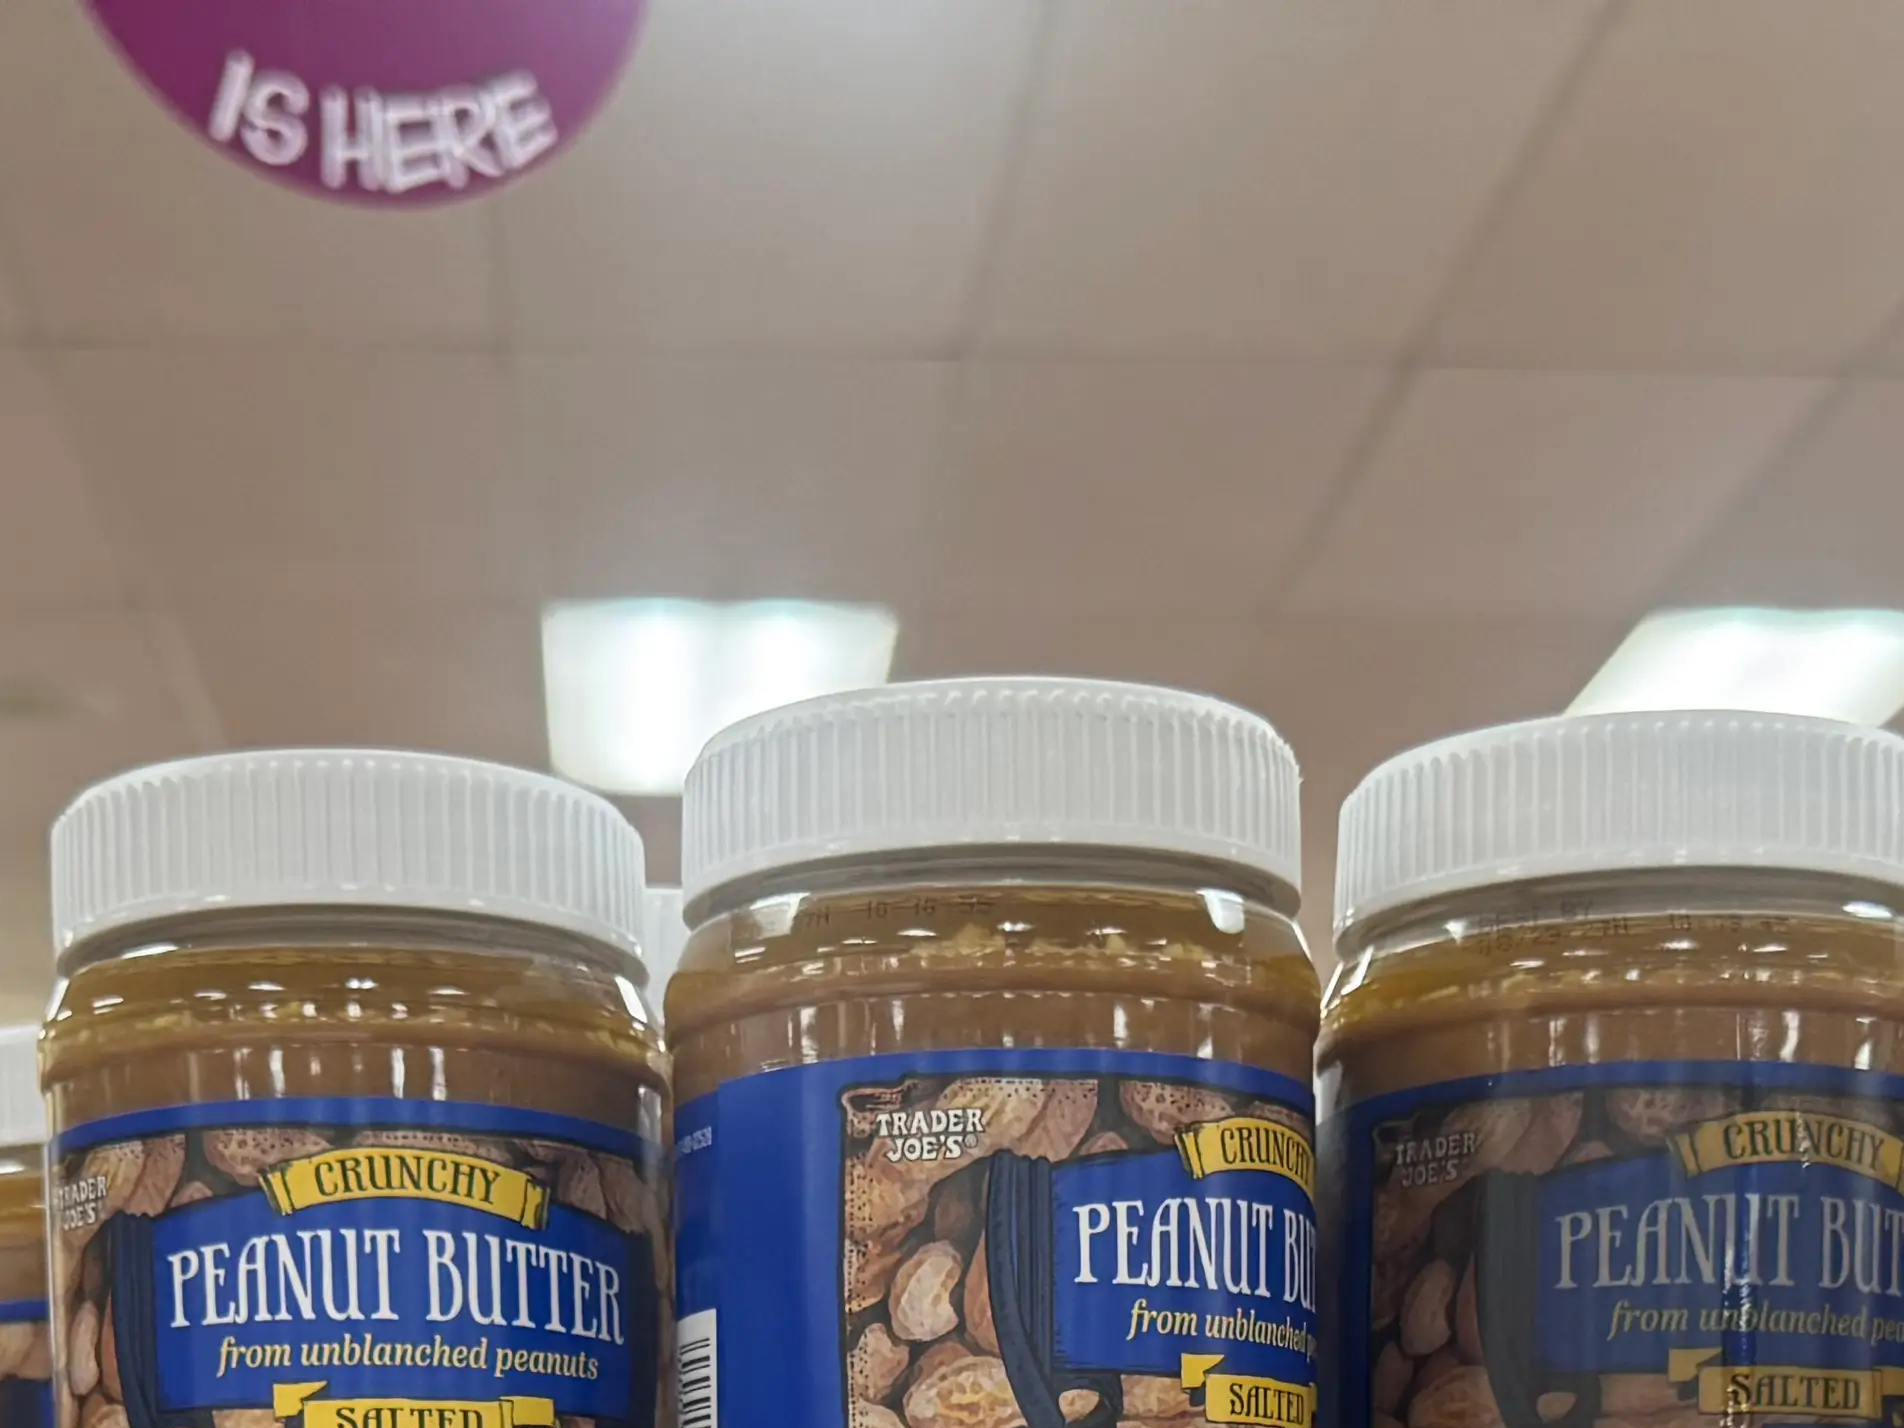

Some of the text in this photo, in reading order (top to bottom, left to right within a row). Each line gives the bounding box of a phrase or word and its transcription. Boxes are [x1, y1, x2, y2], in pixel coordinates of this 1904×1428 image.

[208, 50, 559, 192] IS HERE
[875, 1108, 985, 1138] TRADER
[1722, 1119, 1885, 1171] CRUNCHY
[1395, 1132, 1475, 1165] TRADER
[314, 1157, 502, 1205] CRUNCHY
[1072, 1198, 1274, 1298] PEANUT
[1555, 1194, 1800, 1290] PEANUT
[167, 1228, 625, 1346] PEANUT BUTTER
[1127, 1299, 1309, 1353] from unblanched
[1607, 1302, 1866, 1339] from unblanched
[217, 1334, 599, 1381] from unblanched peanuts
[1229, 1383, 1305, 1428] SALTED
[1730, 1373, 1860, 1410] SALTED
